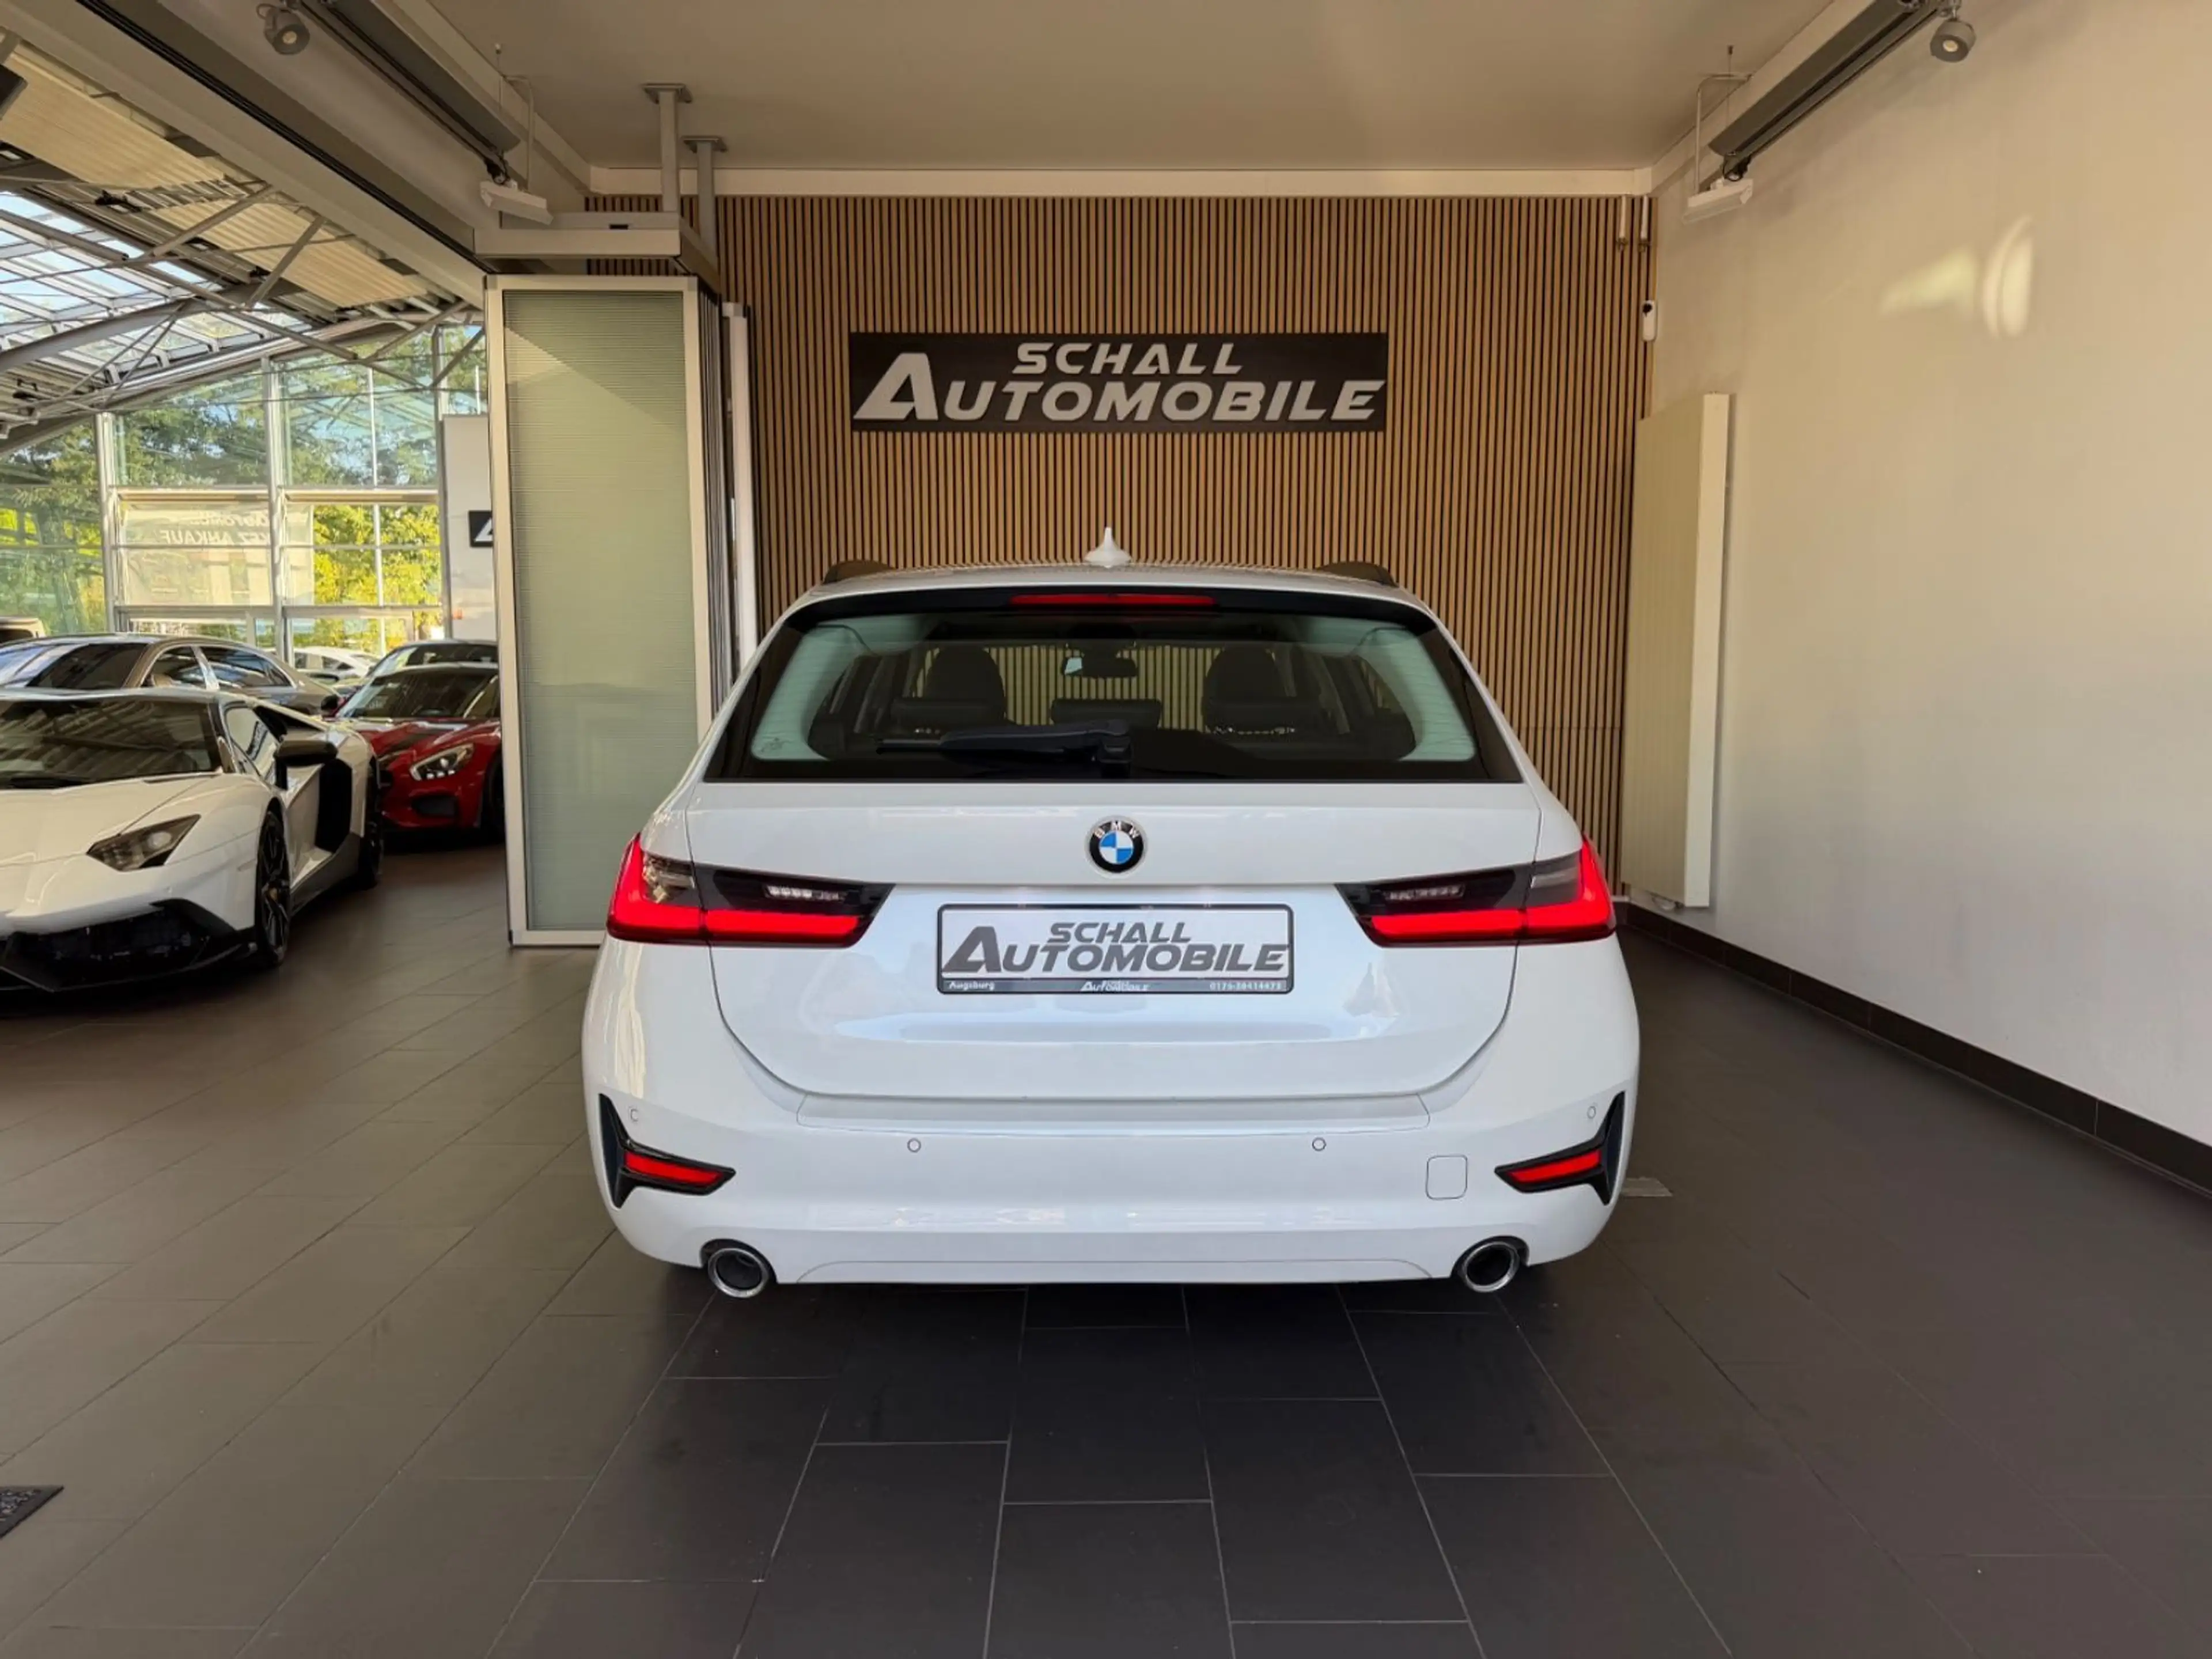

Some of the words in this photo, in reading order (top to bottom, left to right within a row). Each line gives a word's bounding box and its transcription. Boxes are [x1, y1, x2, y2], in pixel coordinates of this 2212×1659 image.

[1012, 342, 1243, 374] SCHALL
[854, 353, 1385, 421] AUTOMOBILE
[1093, 820, 1141, 839] BMW
[1047, 922, 1191, 943] SCHALL
[942, 926, 1288, 972] AUTOMOBILE
[949, 980, 995, 991] Augsburg
